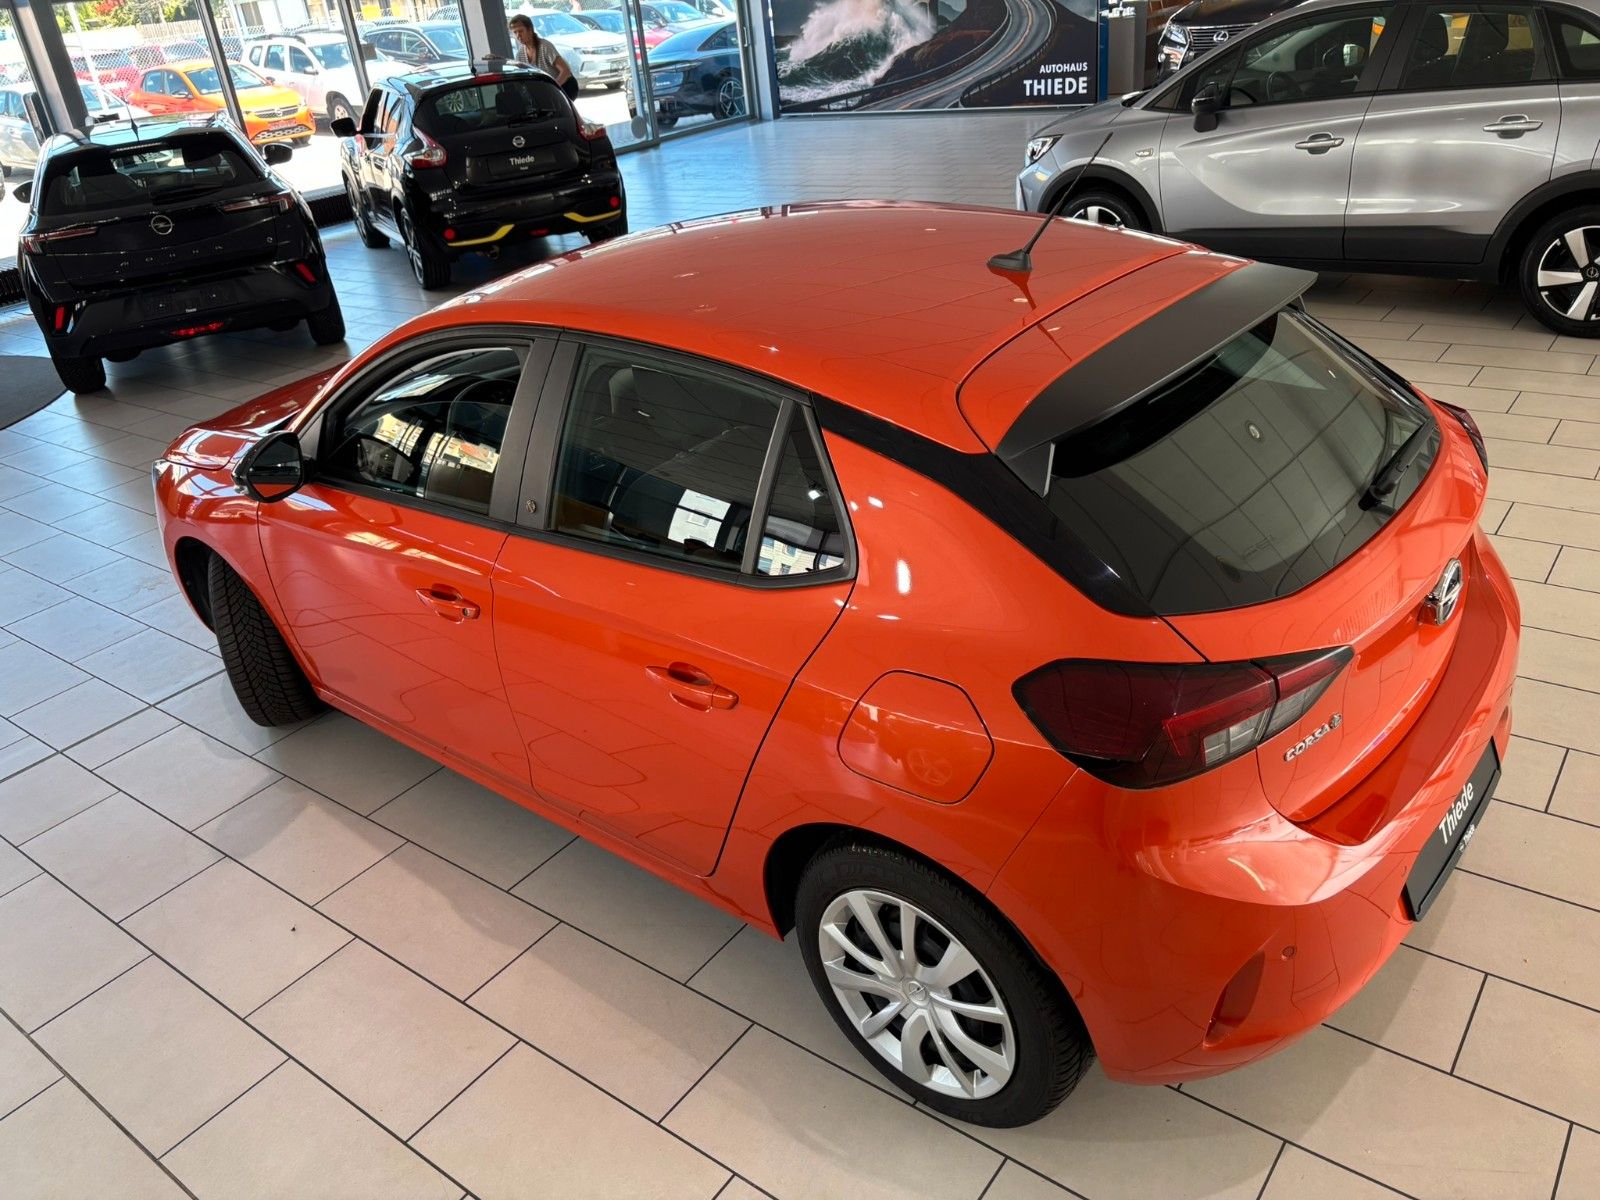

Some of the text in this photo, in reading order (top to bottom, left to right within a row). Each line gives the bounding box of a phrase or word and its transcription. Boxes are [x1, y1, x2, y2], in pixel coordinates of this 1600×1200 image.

[1039, 62, 1088, 74] AUTOHAUS
[1023, 76, 1088, 97] THIEDE
[509, 155, 535, 166] Thiede
[1284, 723, 1331, 762] CORSA
[1438, 781, 1475, 845] Thiede
